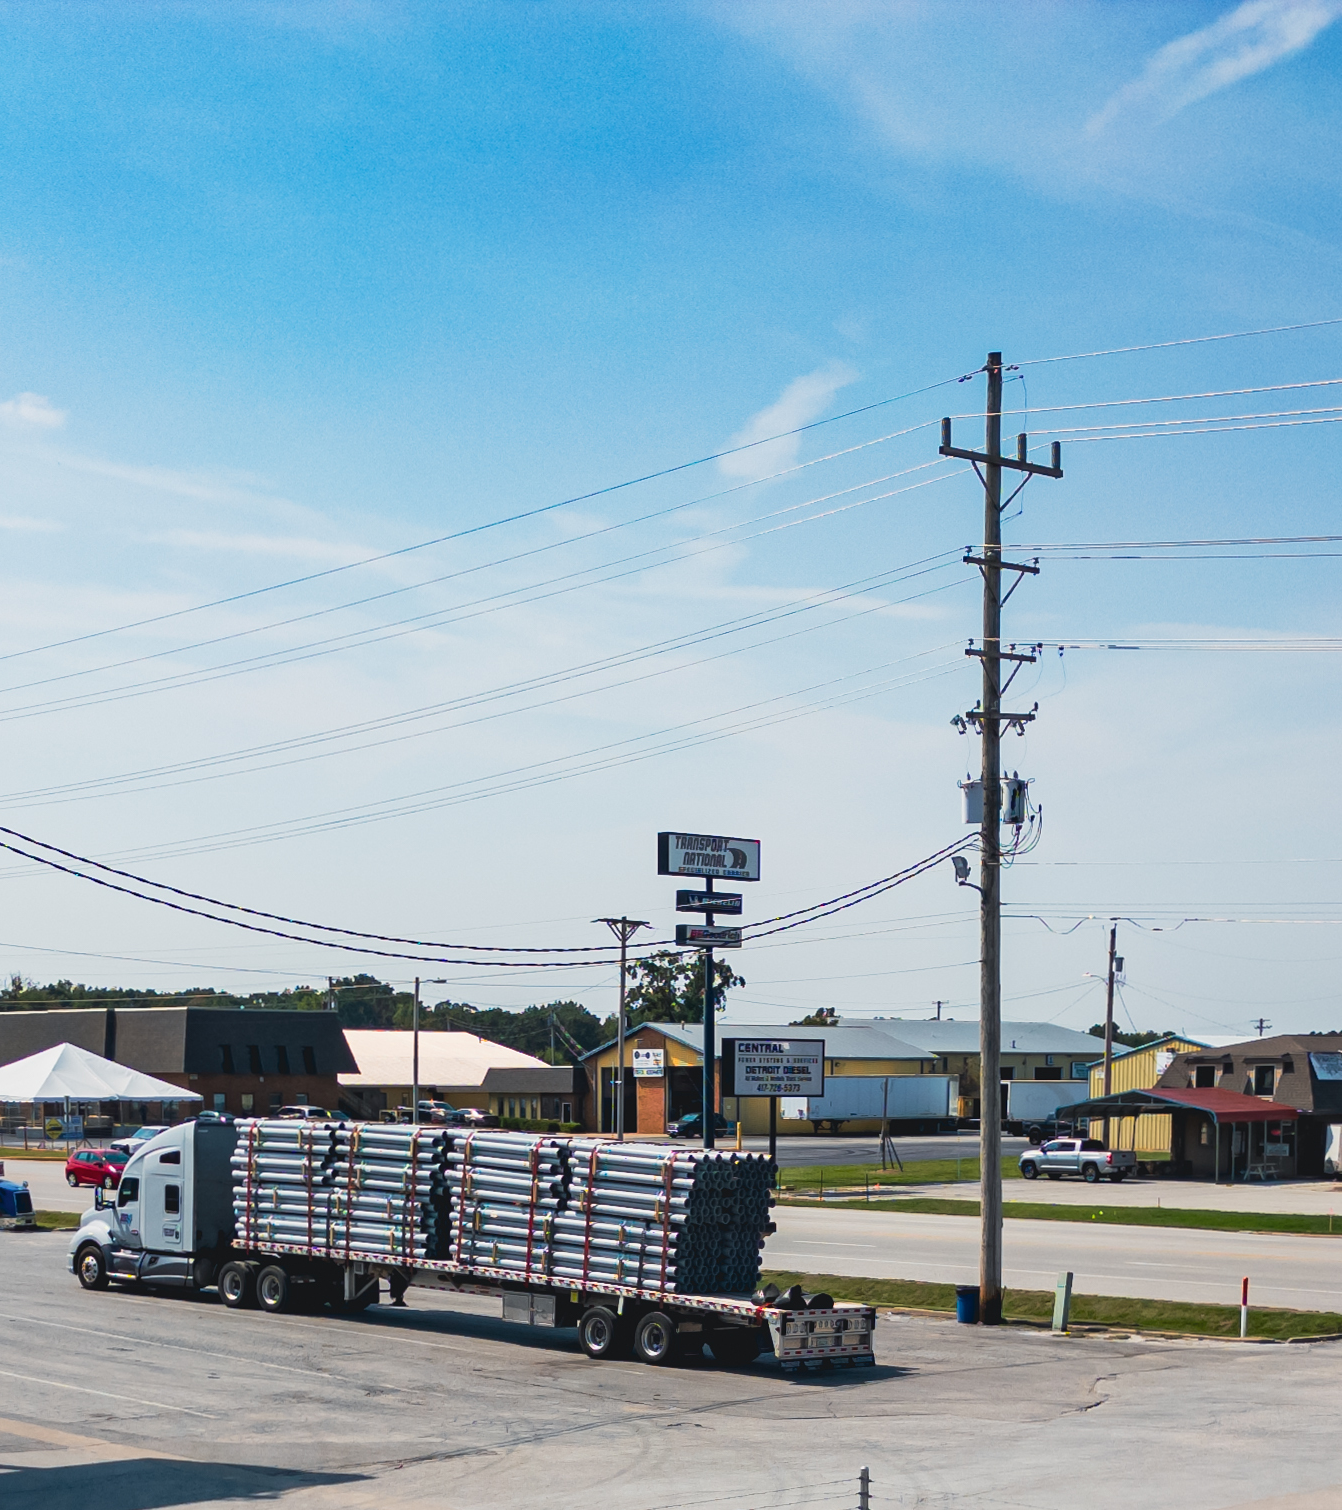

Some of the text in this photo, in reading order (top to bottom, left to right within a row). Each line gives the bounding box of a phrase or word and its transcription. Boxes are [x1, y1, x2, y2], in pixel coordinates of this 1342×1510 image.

[675, 835, 730, 853] TRANSPORT
[683, 851, 728, 868] NATIONAL
[738, 1043, 784, 1053] CENTRAL
[745, 1066, 811, 1074] DETROIT DIESEL
